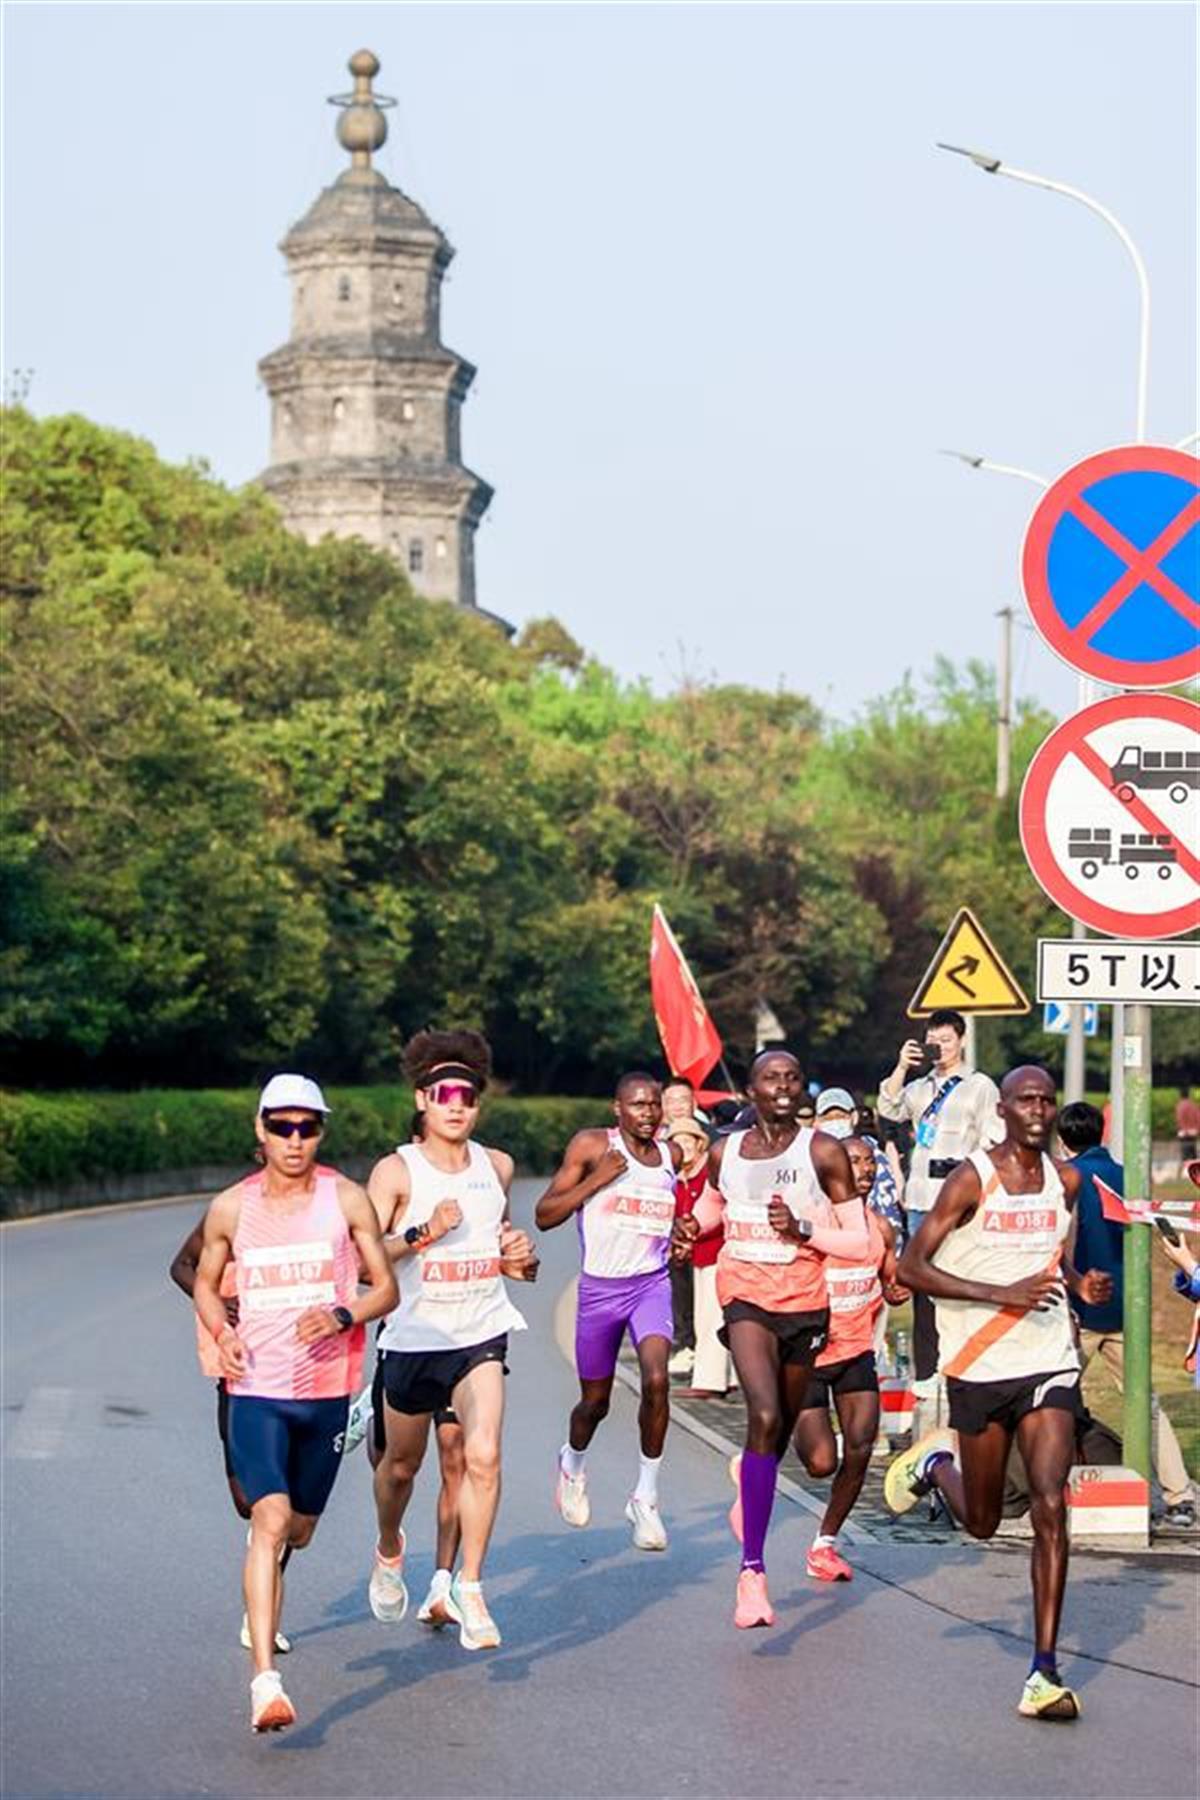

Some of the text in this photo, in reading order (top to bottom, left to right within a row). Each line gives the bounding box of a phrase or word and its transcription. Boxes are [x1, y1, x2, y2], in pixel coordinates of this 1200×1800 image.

[1068, 954, 1200, 992] 5T以
[616, 1198, 629, 1213] A
[729, 1221, 739, 1238] A
[986, 1213, 1002, 1229] A
[249, 1266, 264, 1286] A
[426, 1260, 492, 1281] A 0107
